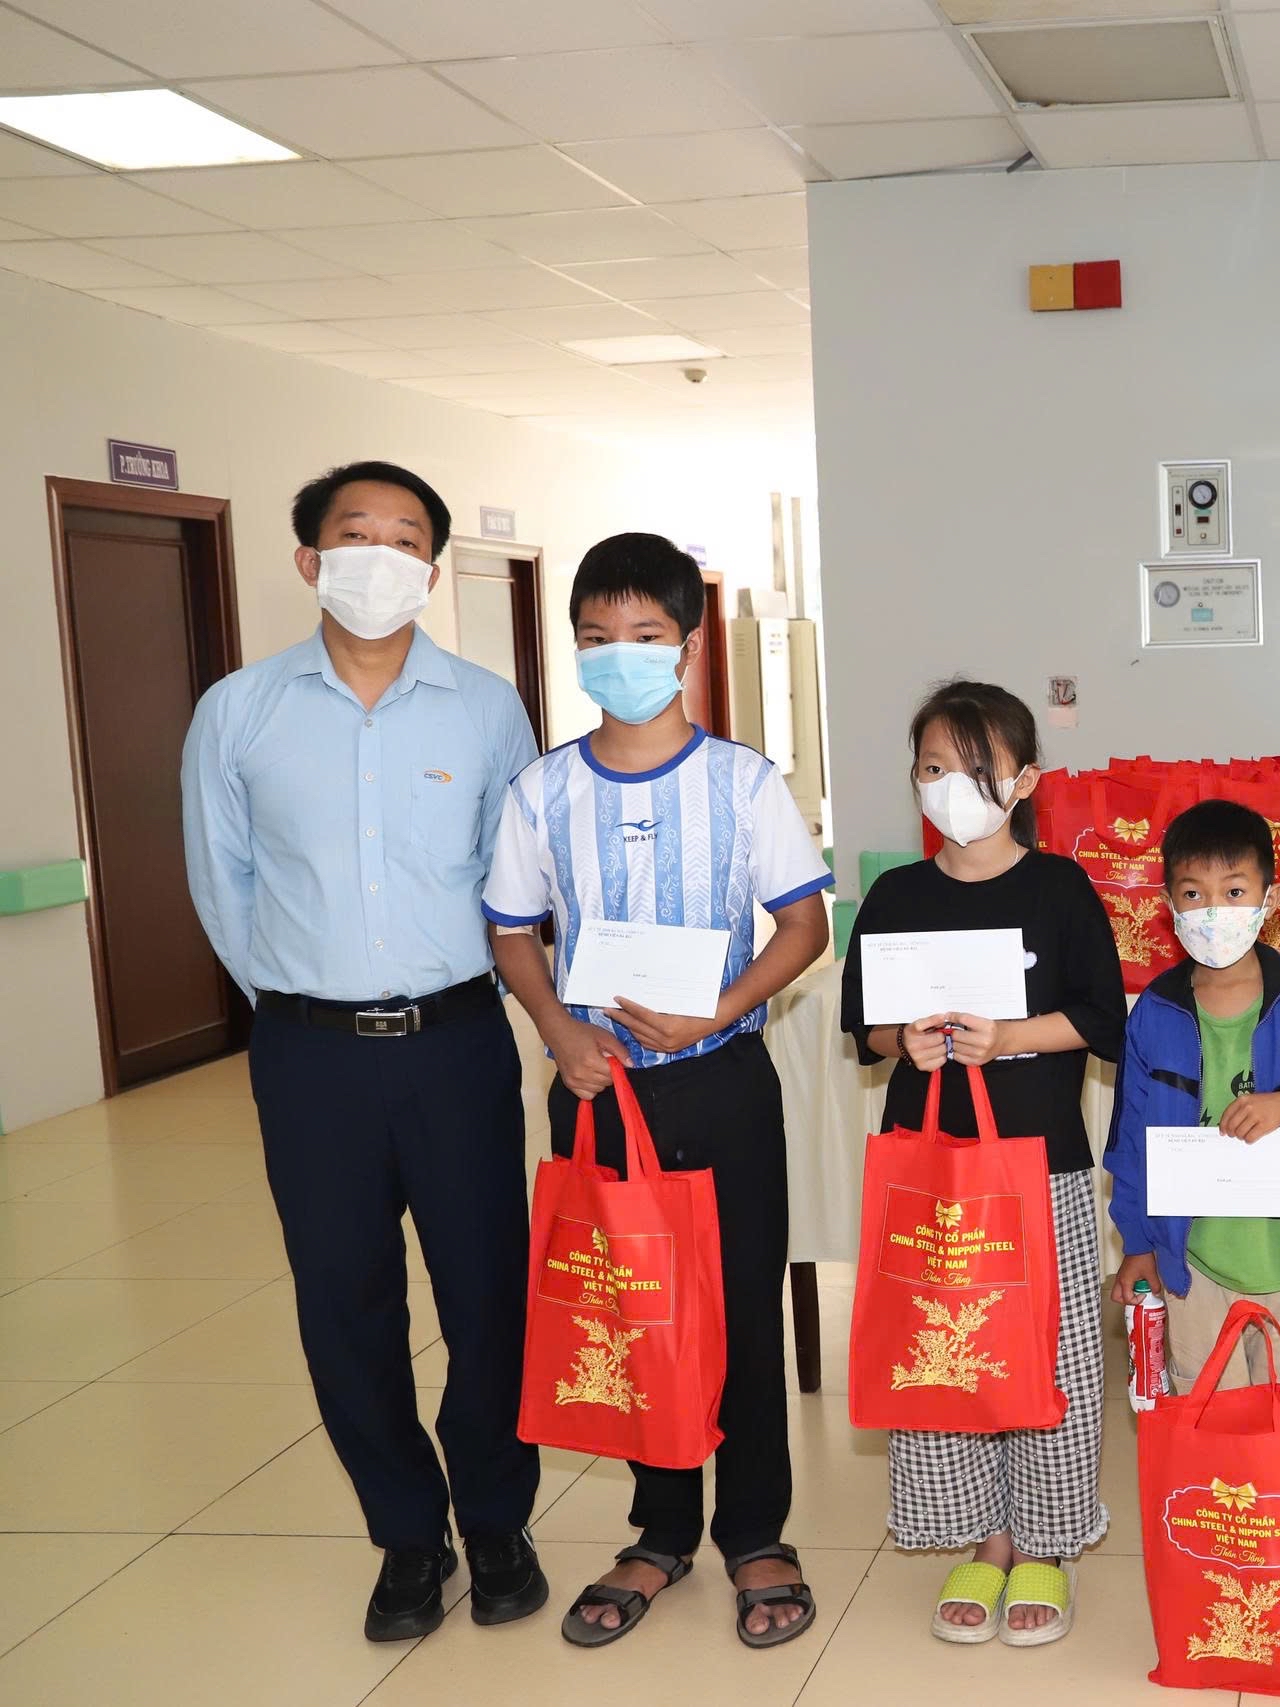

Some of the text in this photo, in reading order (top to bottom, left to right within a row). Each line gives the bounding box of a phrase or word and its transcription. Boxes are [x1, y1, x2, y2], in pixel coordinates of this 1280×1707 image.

[151, 460, 169, 480] KHOA
[648, 832, 658, 840] FLY
[1101, 852, 1122, 860] STEEL
[1112, 862, 1127, 870] VIỆT
[916, 1225, 935, 1238] CÔNG
[935, 1231, 943, 1240] TY
[945, 1230, 959, 1242] CỔ
[890, 1233, 1015, 1256] CHINA STEEL & NIPPON STEEL
[569, 1251, 591, 1263] CÔNG
[594, 1256, 604, 1266] TY
[928, 1256, 967, 1269] VIỆT NAM
[548, 1259, 569, 1272] CHINA
[571, 1264, 596, 1278] STEEL
[598, 1271, 604, 1280] &
[630, 1281, 662, 1291] STEEL
[584, 1280, 602, 1293] VIỆT
[1196, 1508, 1220, 1519] CÔNG
[1222, 1512, 1232, 1522] TY
[1235, 1513, 1247, 1524] CỔ
[1172, 1517, 1198, 1527] CHINA
[1201, 1521, 1227, 1532] STEEL
[1230, 1526, 1236, 1534] &
[1239, 1527, 1272, 1538] NIPPON
[1216, 1534, 1257, 1548] VIỆT NAM
[1211, 1545, 1237, 1558] Thân
